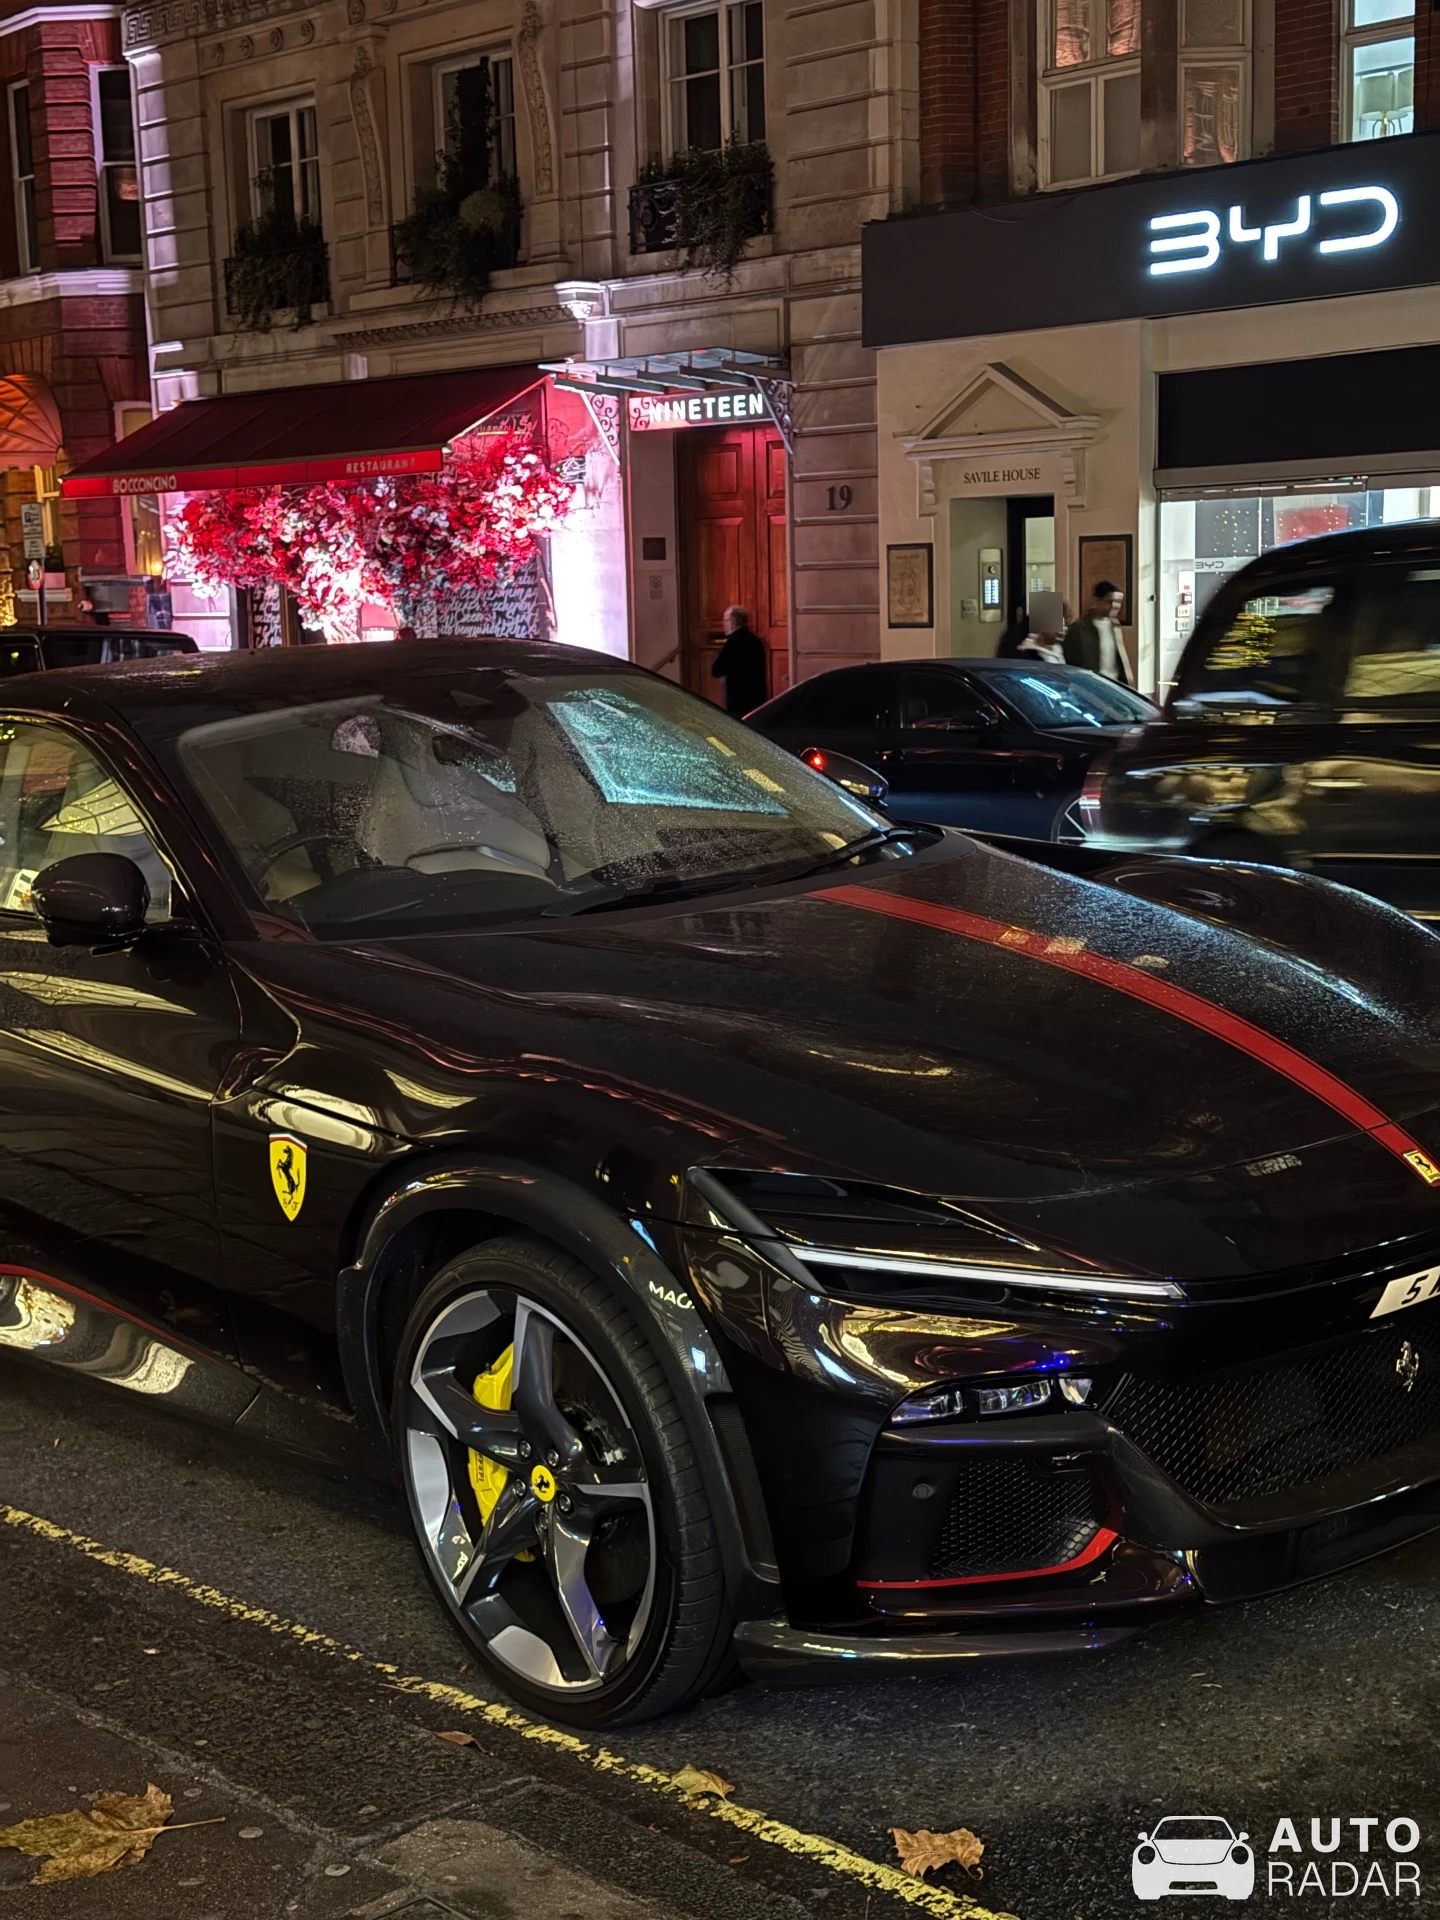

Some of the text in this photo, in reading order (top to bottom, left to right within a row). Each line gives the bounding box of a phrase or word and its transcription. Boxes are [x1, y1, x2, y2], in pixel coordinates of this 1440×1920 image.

[1150, 186, 1399, 275] BYD
[649, 393, 763, 422] NINETEEN
[345, 457, 416, 474] RESTAURANT
[113, 474, 177, 494] BOCCONCINO
[963, 468, 1041, 484] SAVILE HOUSE
[826, 485, 854, 511] 19
[1194, 560, 1225, 570] BYD
